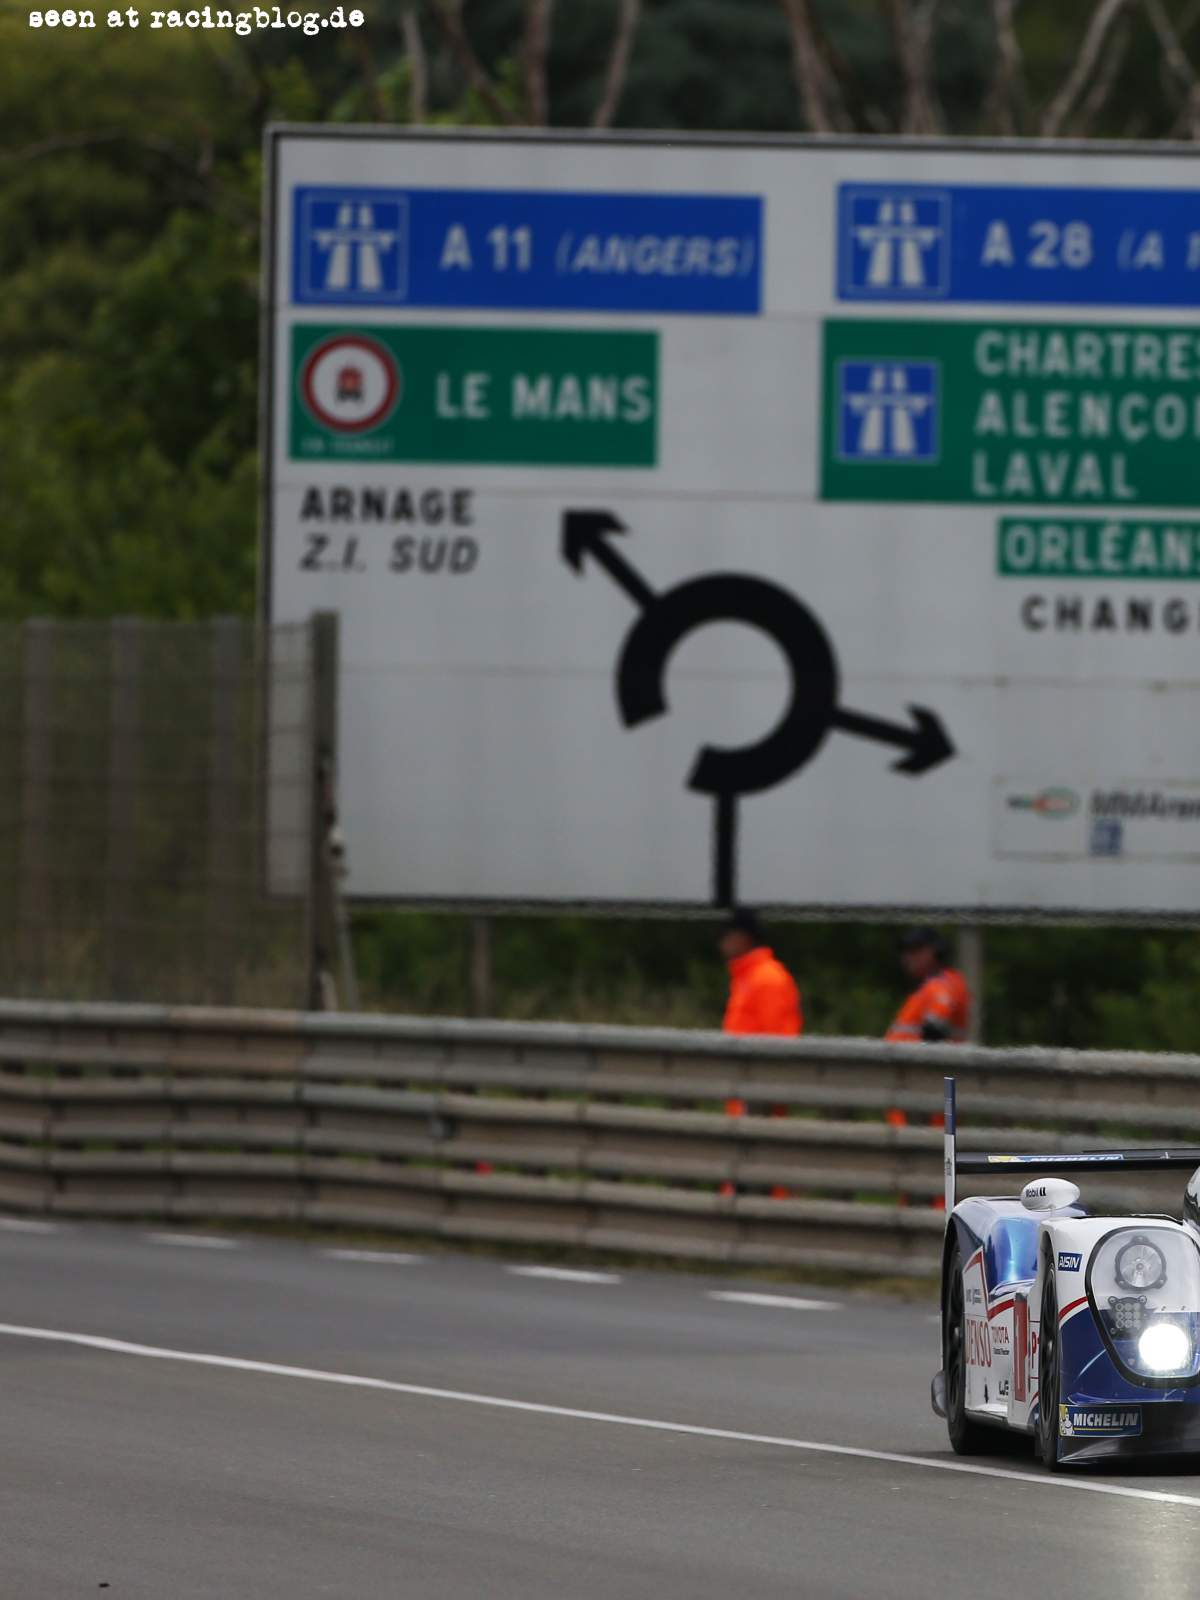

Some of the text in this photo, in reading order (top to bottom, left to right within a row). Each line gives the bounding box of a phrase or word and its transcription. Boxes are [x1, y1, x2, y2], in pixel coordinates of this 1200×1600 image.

[439, 224, 755, 278] A 11 (ANGERS)
[980, 218, 1015, 269] A
[1026, 218, 1093, 270] 28
[1117, 227, 1165, 272] (A
[435, 372, 653, 423] LE MANS
[972, 450, 1140, 499] LAVAL
[300, 485, 476, 527] ARNAGE
[298, 531, 481, 575] Z.I. SUD
[1058, 1255, 1081, 1269] AISIN
[966, 1319, 993, 1368] DENSO
[1073, 1412, 1139, 1427] MICHELIN
